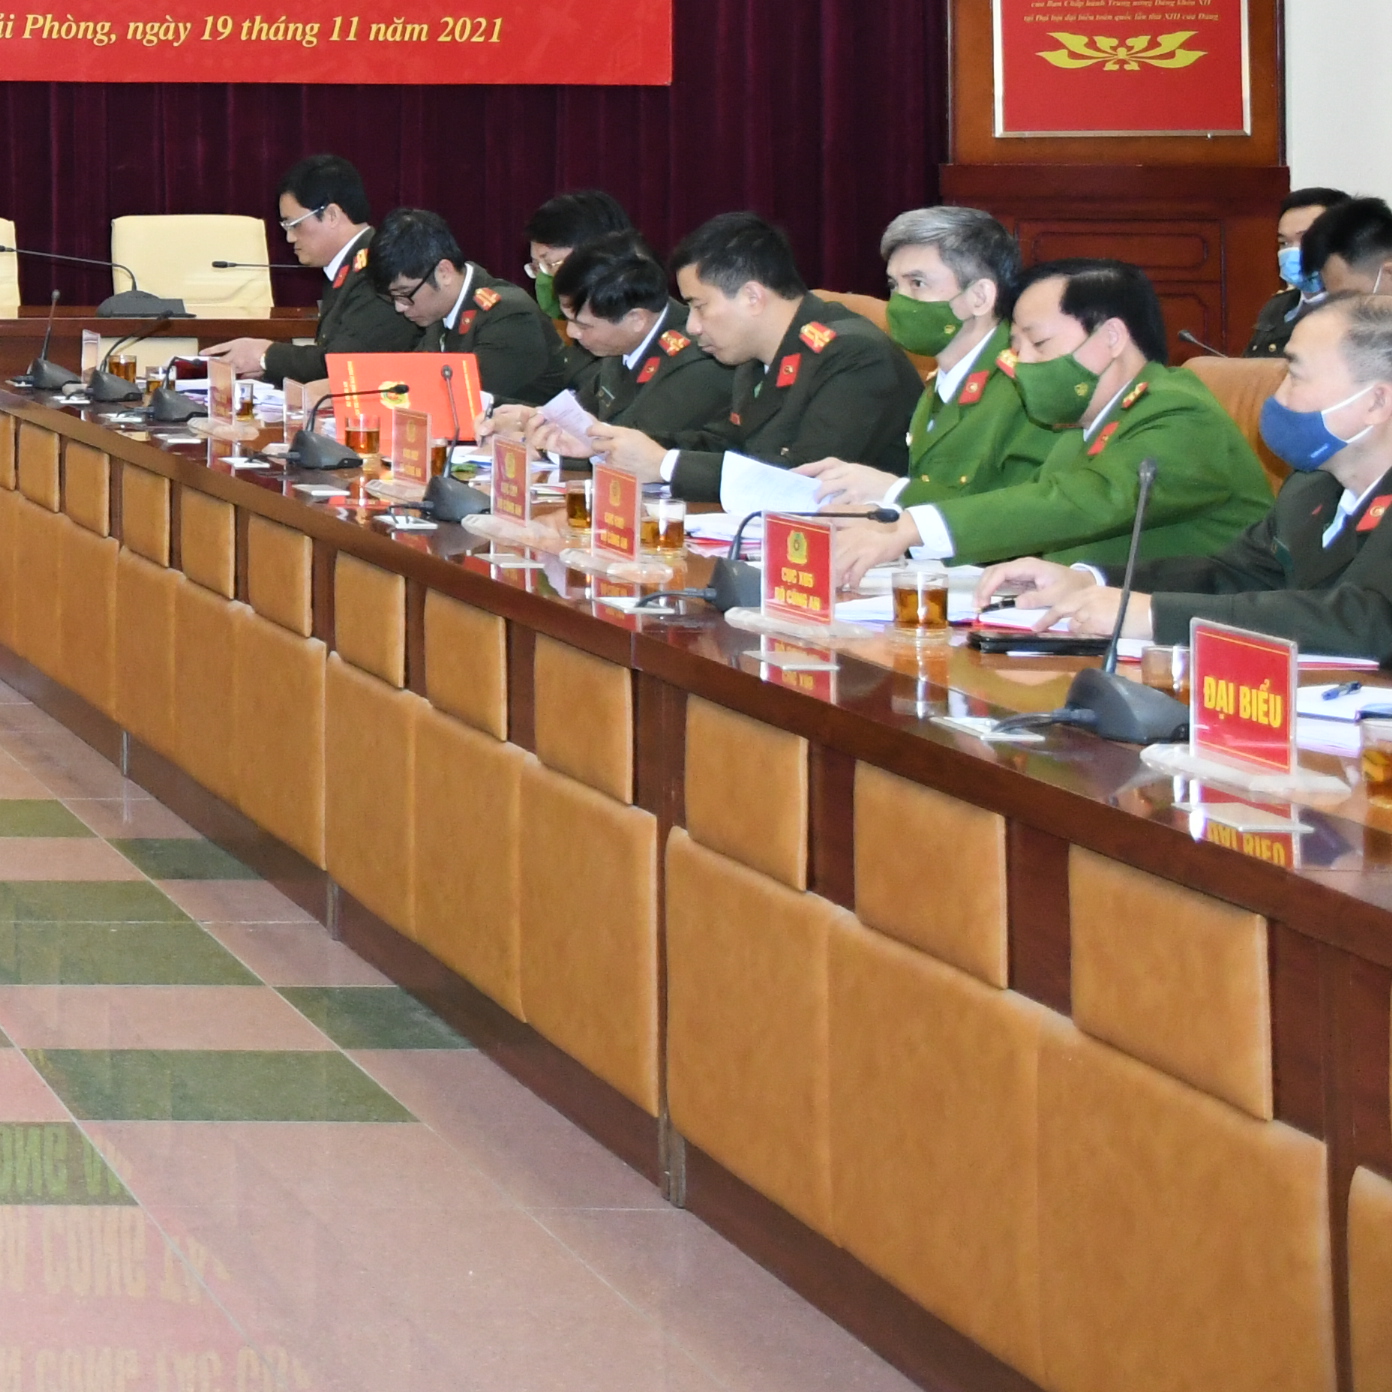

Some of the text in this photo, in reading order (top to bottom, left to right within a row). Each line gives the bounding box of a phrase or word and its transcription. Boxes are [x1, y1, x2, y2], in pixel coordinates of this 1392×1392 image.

[23, 14, 116, 46] Phòng,
[127, 15, 191, 46] ngày
[201, 16, 232, 40] 19
[241, 16, 320, 47] tháng
[330, 16, 358, 40] 11
[370, 17, 428, 41] năm
[438, 17, 502, 42] 2021
[1203, 676, 1282, 729] ĐẠI BIỂU
